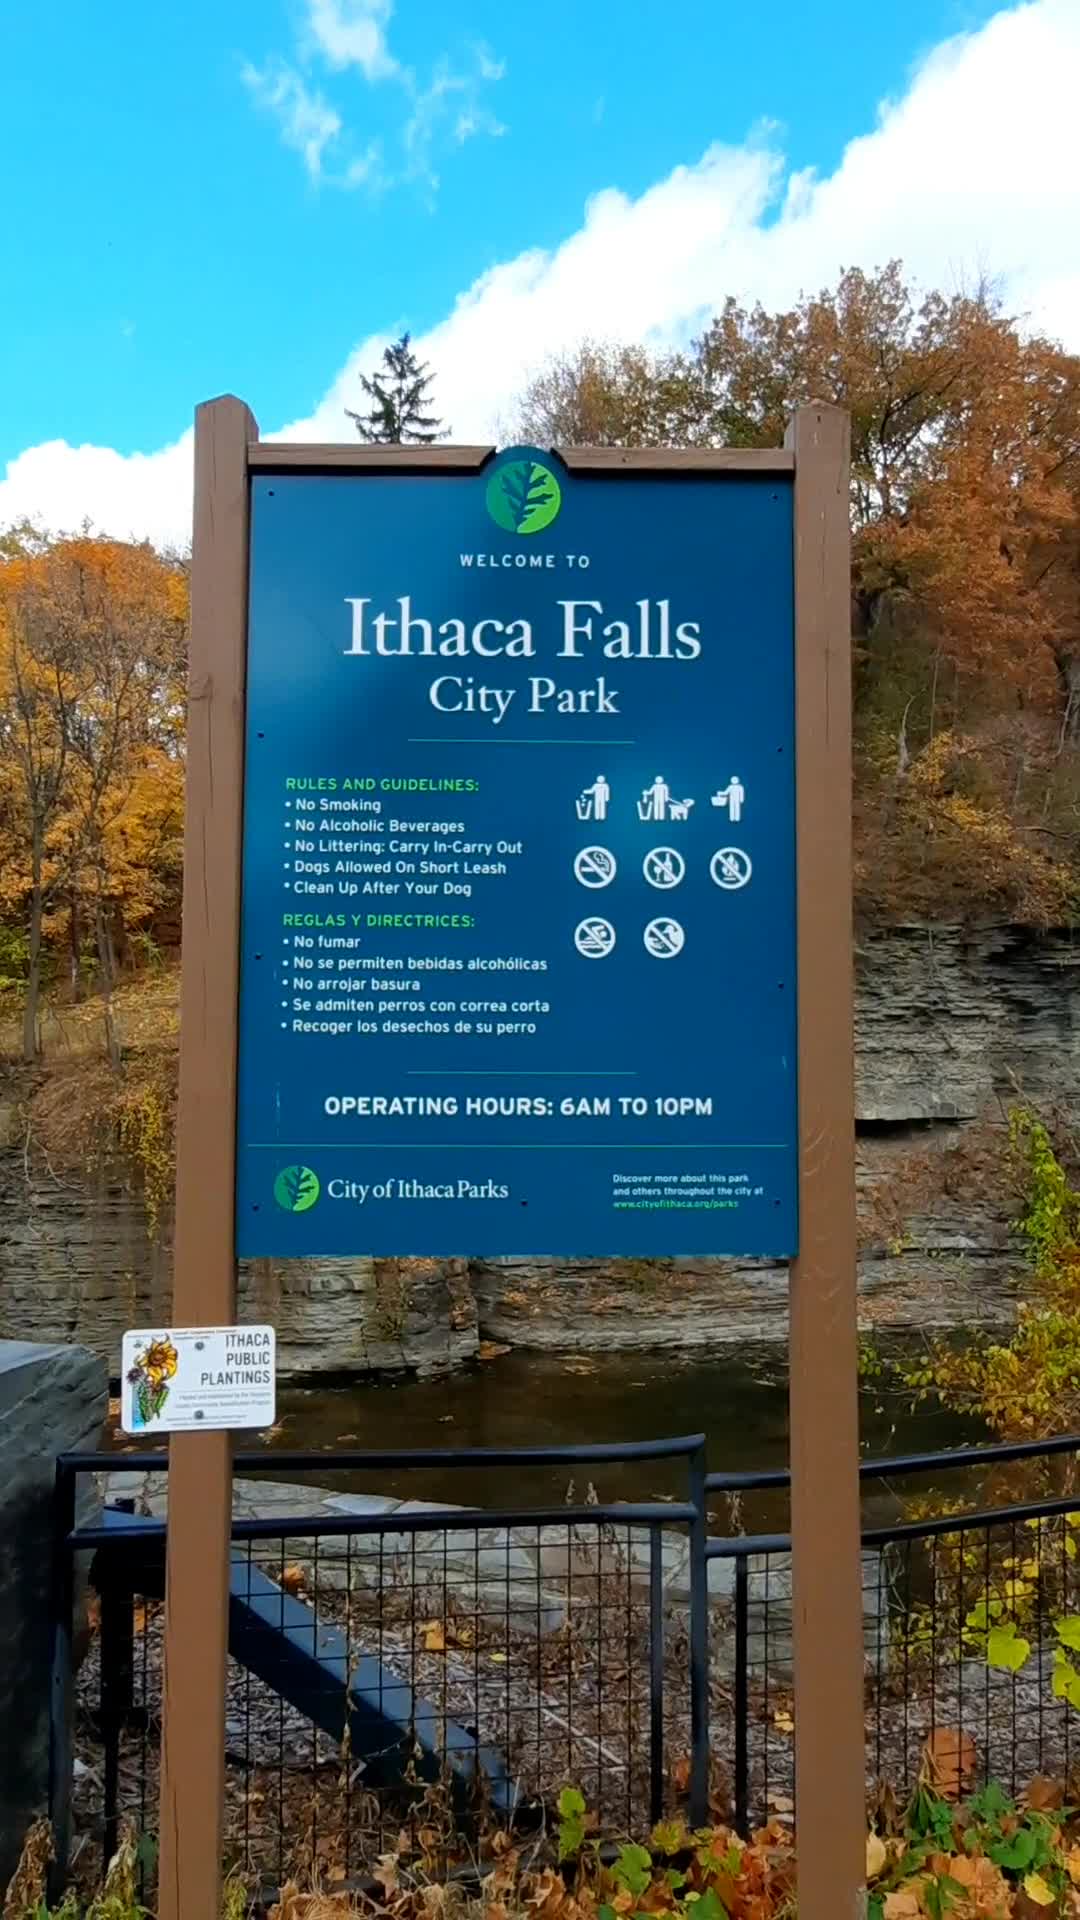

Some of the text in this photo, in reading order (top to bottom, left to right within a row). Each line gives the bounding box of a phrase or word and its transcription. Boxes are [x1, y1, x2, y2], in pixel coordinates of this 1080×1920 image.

[460, 554, 590, 569] WELCOME TO
[343, 595, 701, 660] Ithaca Falls
[429, 675, 620, 723] City Park
[286, 778, 479, 791] RULES AND GUIDELINES:
[296, 798, 381, 813] No Smoking
[295, 819, 465, 834] No Alcoholic Beverages
[295, 840, 522, 856] No Littering: Carry In-Carry Out
[295, 860, 506, 875] Dogs Allowed On Short Leash
[294, 881, 472, 897] Clean Up After Your Dog
[283, 914, 475, 928] REGLAS Y DIRECTRICES:
[294, 935, 360, 948] No fumar
[294, 956, 547, 971] No se permiten bebidas alcohólicas
[293, 978, 420, 993] No arrojar basura
[293, 998, 550, 1014] Se admiten perros con correa corta
[293, 1019, 536, 1036] Recoger los desechos de su perro
[325, 1097, 713, 1116] OPERATING HOURS: 6AM TO 10PM
[613, 1174, 652, 1183] Discover
[680, 1174, 706, 1182] about
[728, 1174, 749, 1184] park
[327, 1179, 508, 1203] City of Ithaca Parks
[613, 1187, 763, 1197] and others throughout the city at
[226, 1333, 270, 1347] ITHACA
[227, 1352, 270, 1366] PUBLIC
[201, 1370, 270, 1385] PLANTINGS
